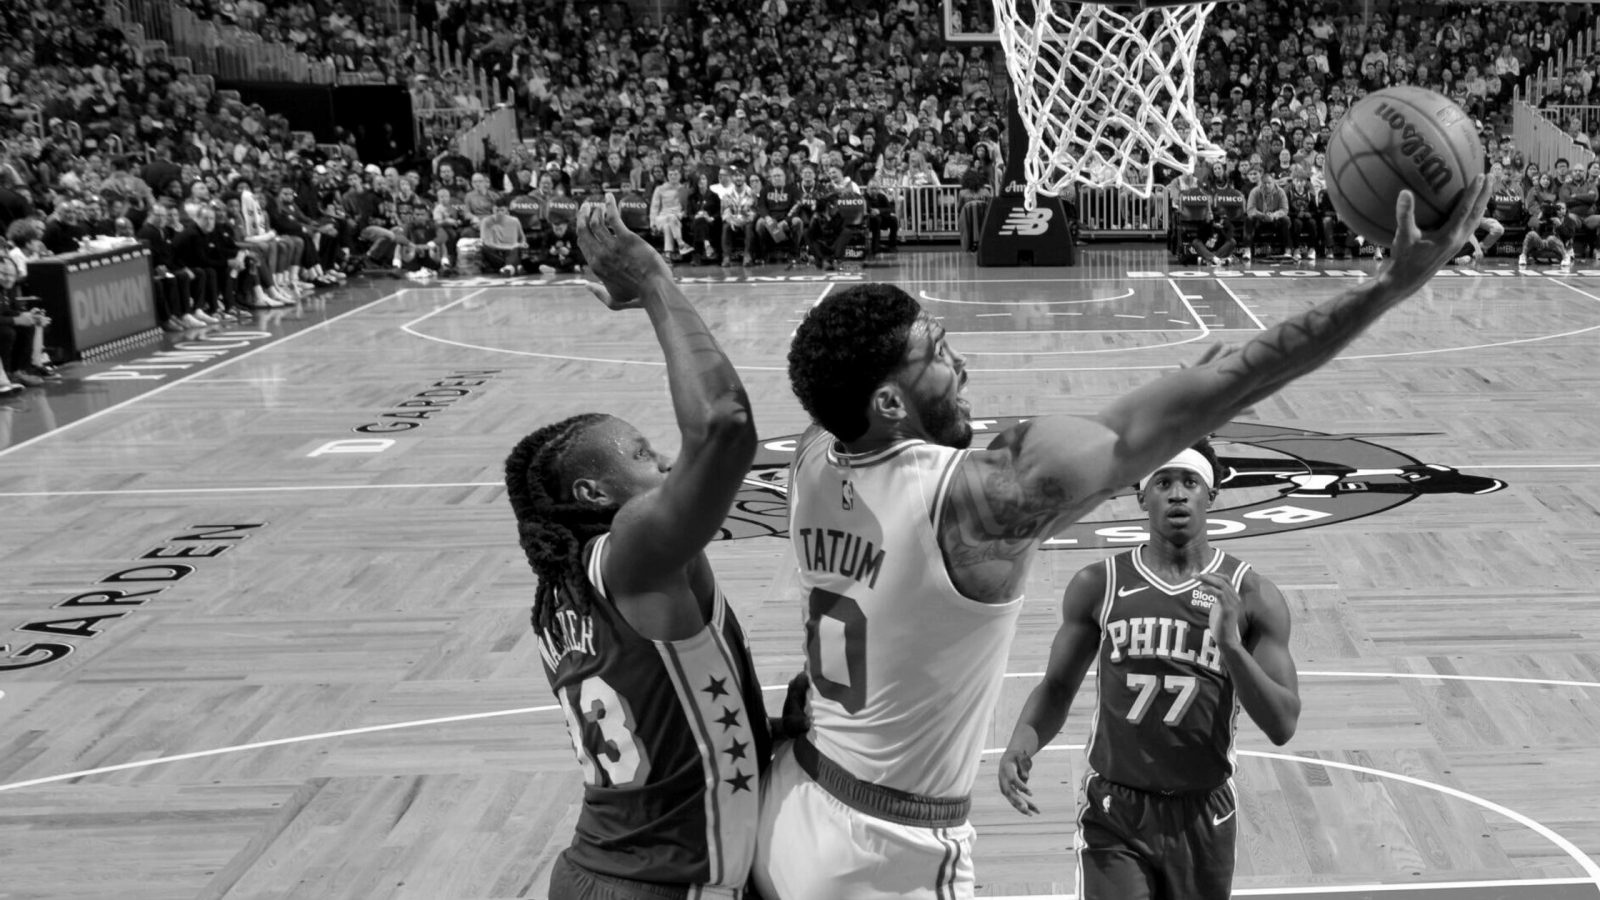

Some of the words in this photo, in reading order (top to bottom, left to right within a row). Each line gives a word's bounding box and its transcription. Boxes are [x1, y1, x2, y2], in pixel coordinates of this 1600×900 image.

[1374, 102, 1453, 194] Wilson
[512, 202, 540, 210] PIMCO
[549, 202, 576, 210] PIMCO
[621, 201, 648, 209] PIMCO
[352, 369, 502, 434] GARDEN
[799, 527, 887, 590] TATUM
[806, 586, 868, 716] 0
[1126, 673, 1200, 727] 77
